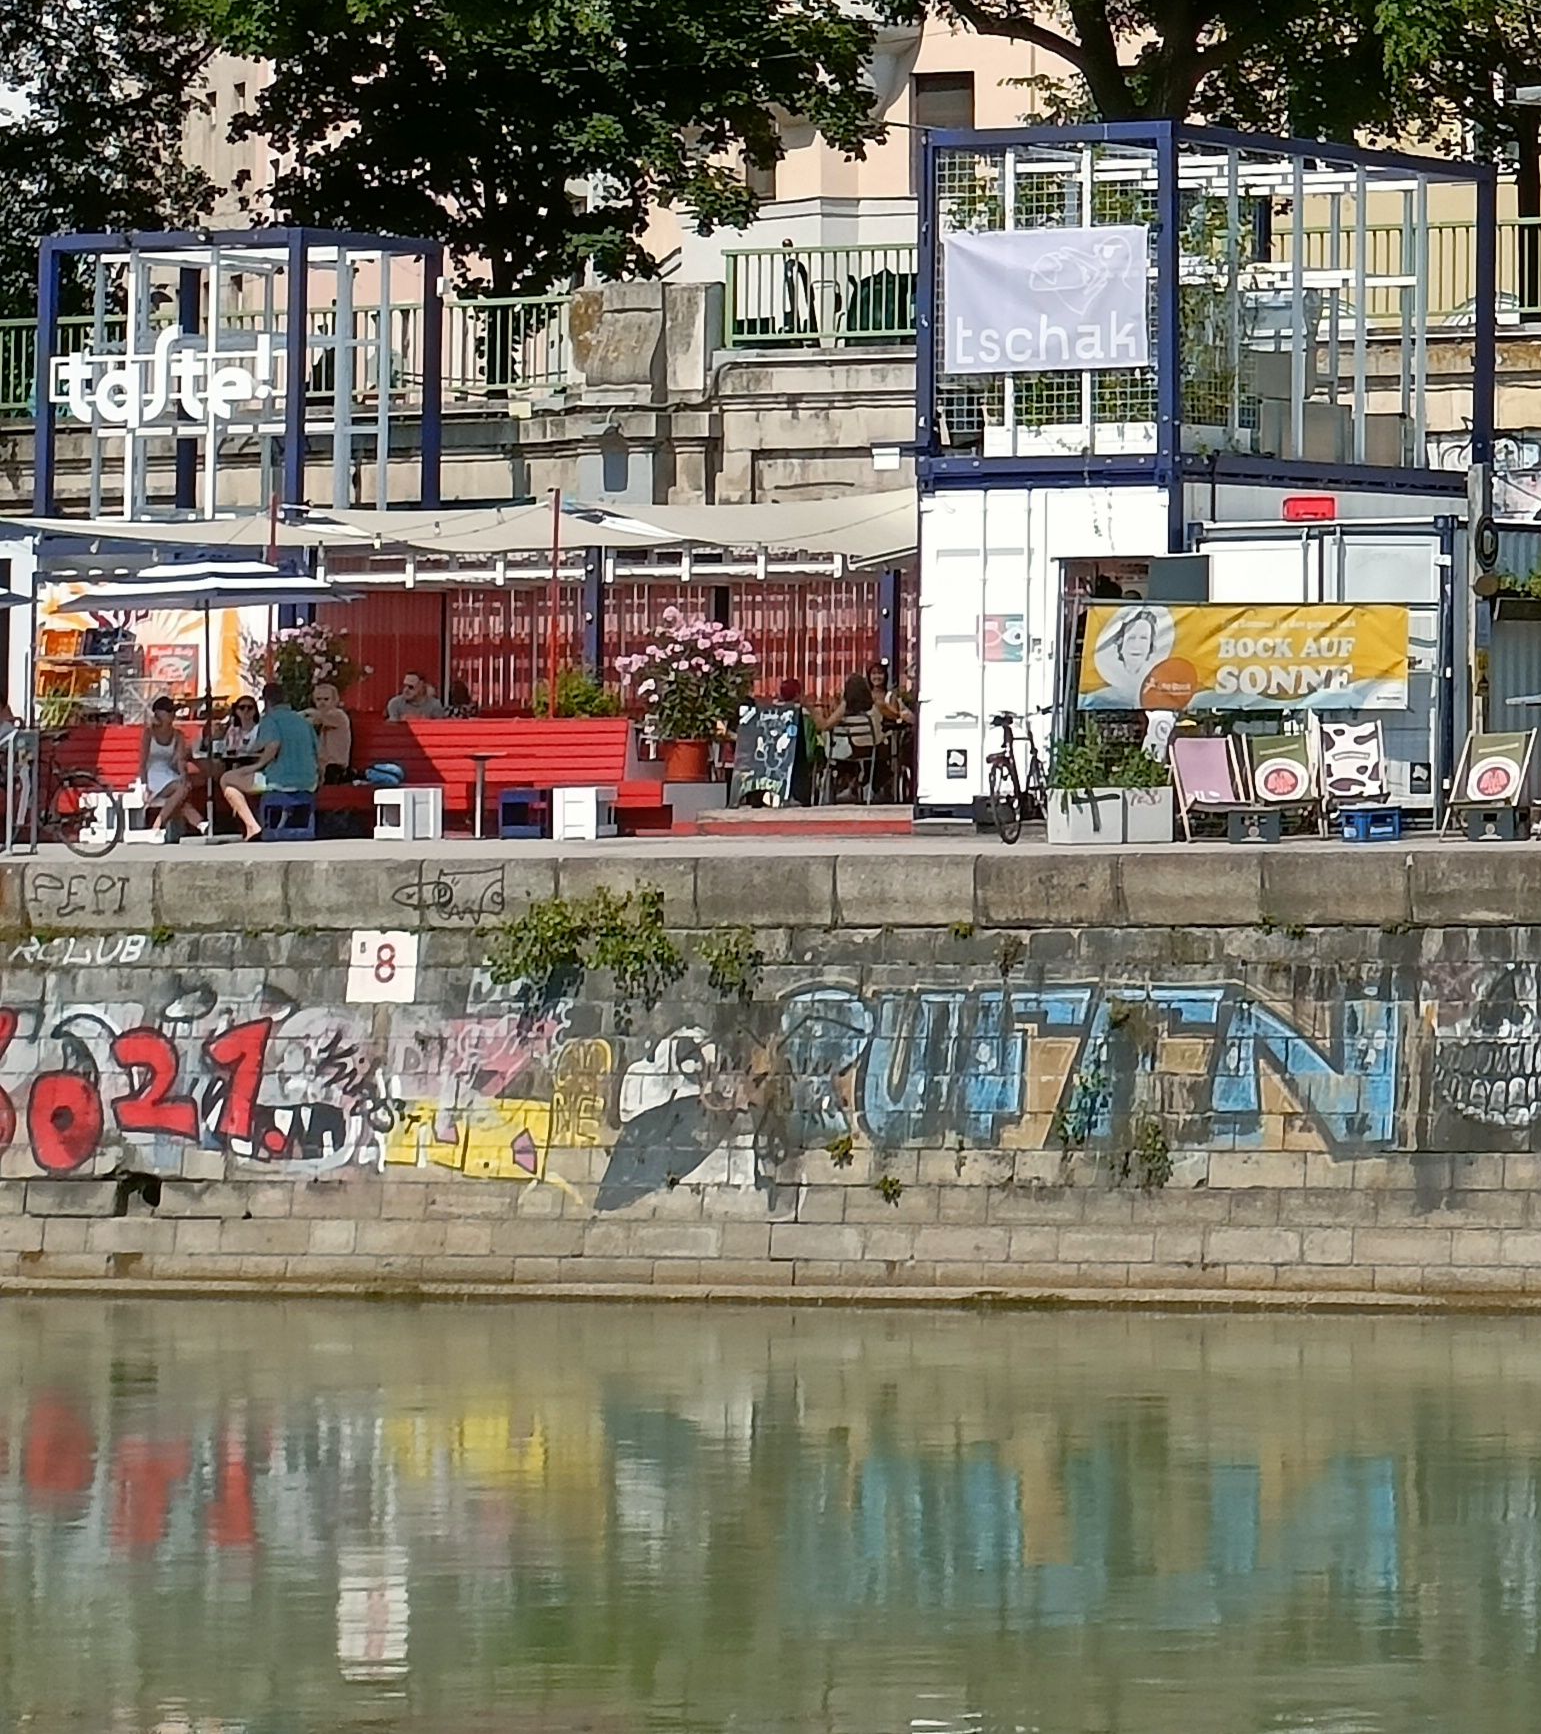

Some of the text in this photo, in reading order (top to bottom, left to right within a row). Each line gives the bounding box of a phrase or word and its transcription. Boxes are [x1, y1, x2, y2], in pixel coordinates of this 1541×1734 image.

[956, 310, 1136, 364] tschak
[58, 324, 271, 428] taste!
[1217, 636, 1356, 659] BOCK AUF
[1214, 664, 1354, 696] SONNE
[375, 943, 396, 984] 8
